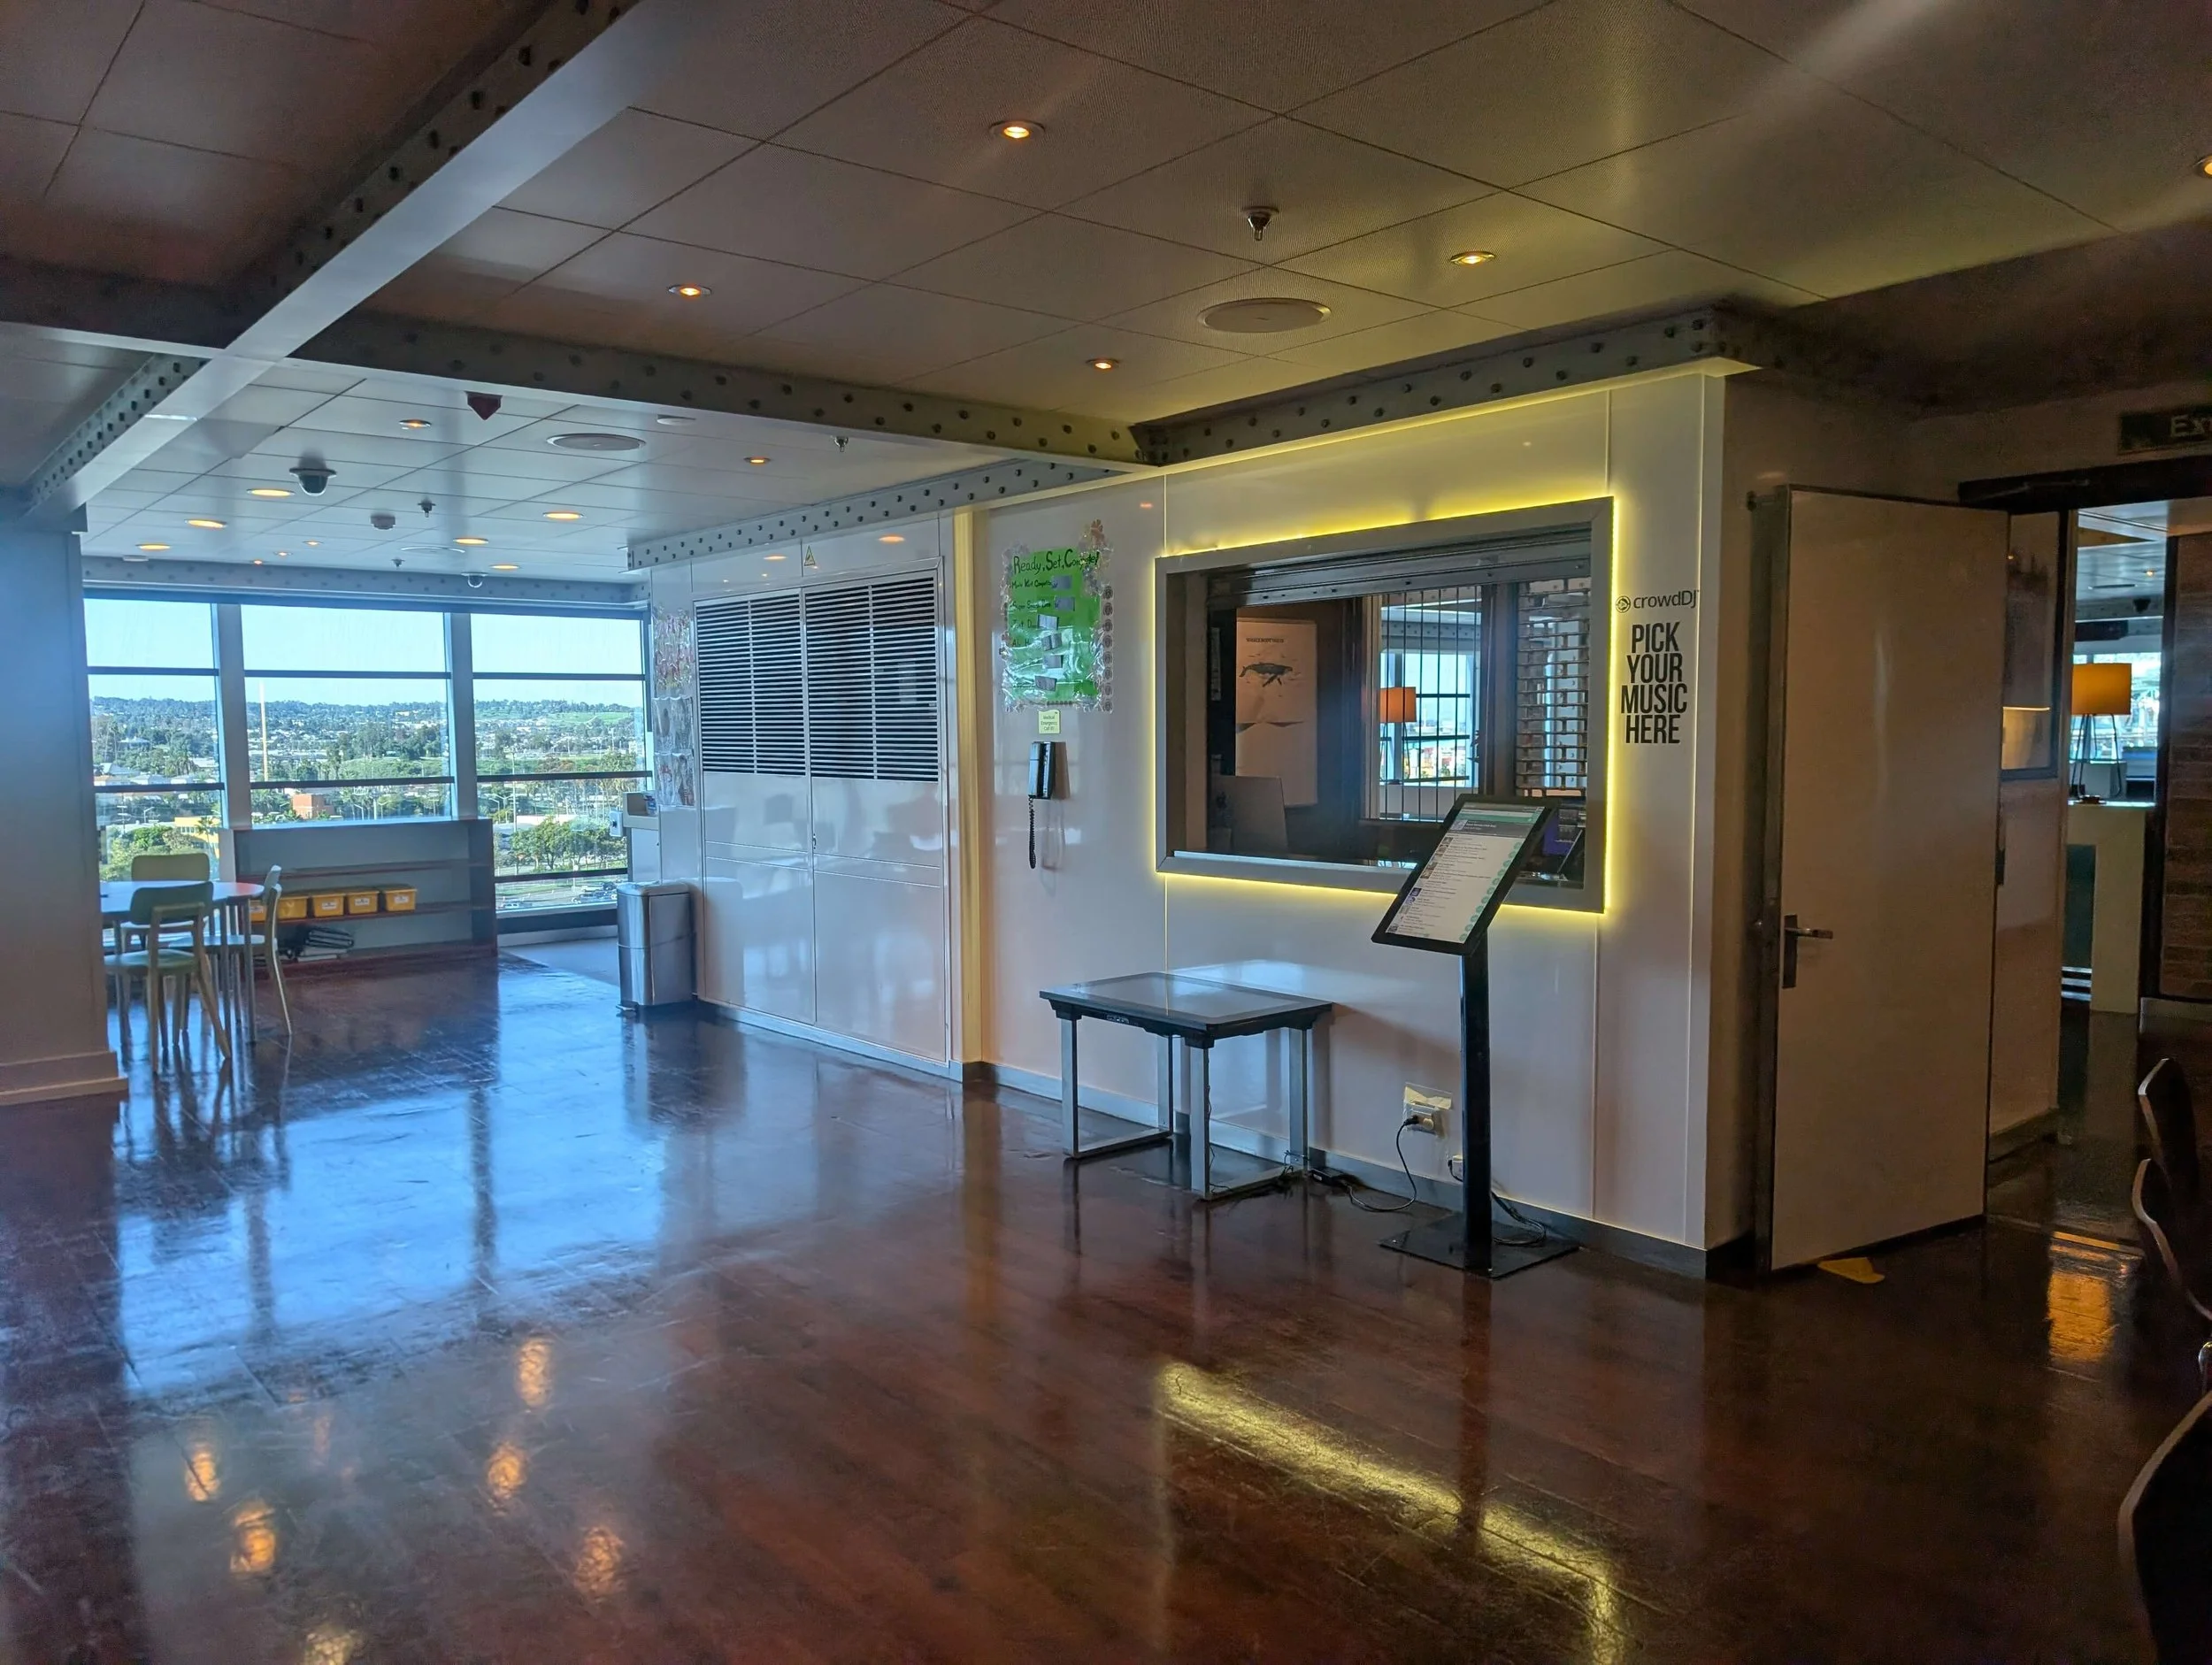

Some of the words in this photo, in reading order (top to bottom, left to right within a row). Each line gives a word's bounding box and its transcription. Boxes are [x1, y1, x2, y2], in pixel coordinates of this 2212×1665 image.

[1633, 590, 1697, 609] crowdDJ
[1632, 621, 1680, 653] PICK
[1626, 653, 1683, 684] YOUR
[1621, 683, 1687, 714] MUSIC
[1625, 715, 1681, 744] HERE
